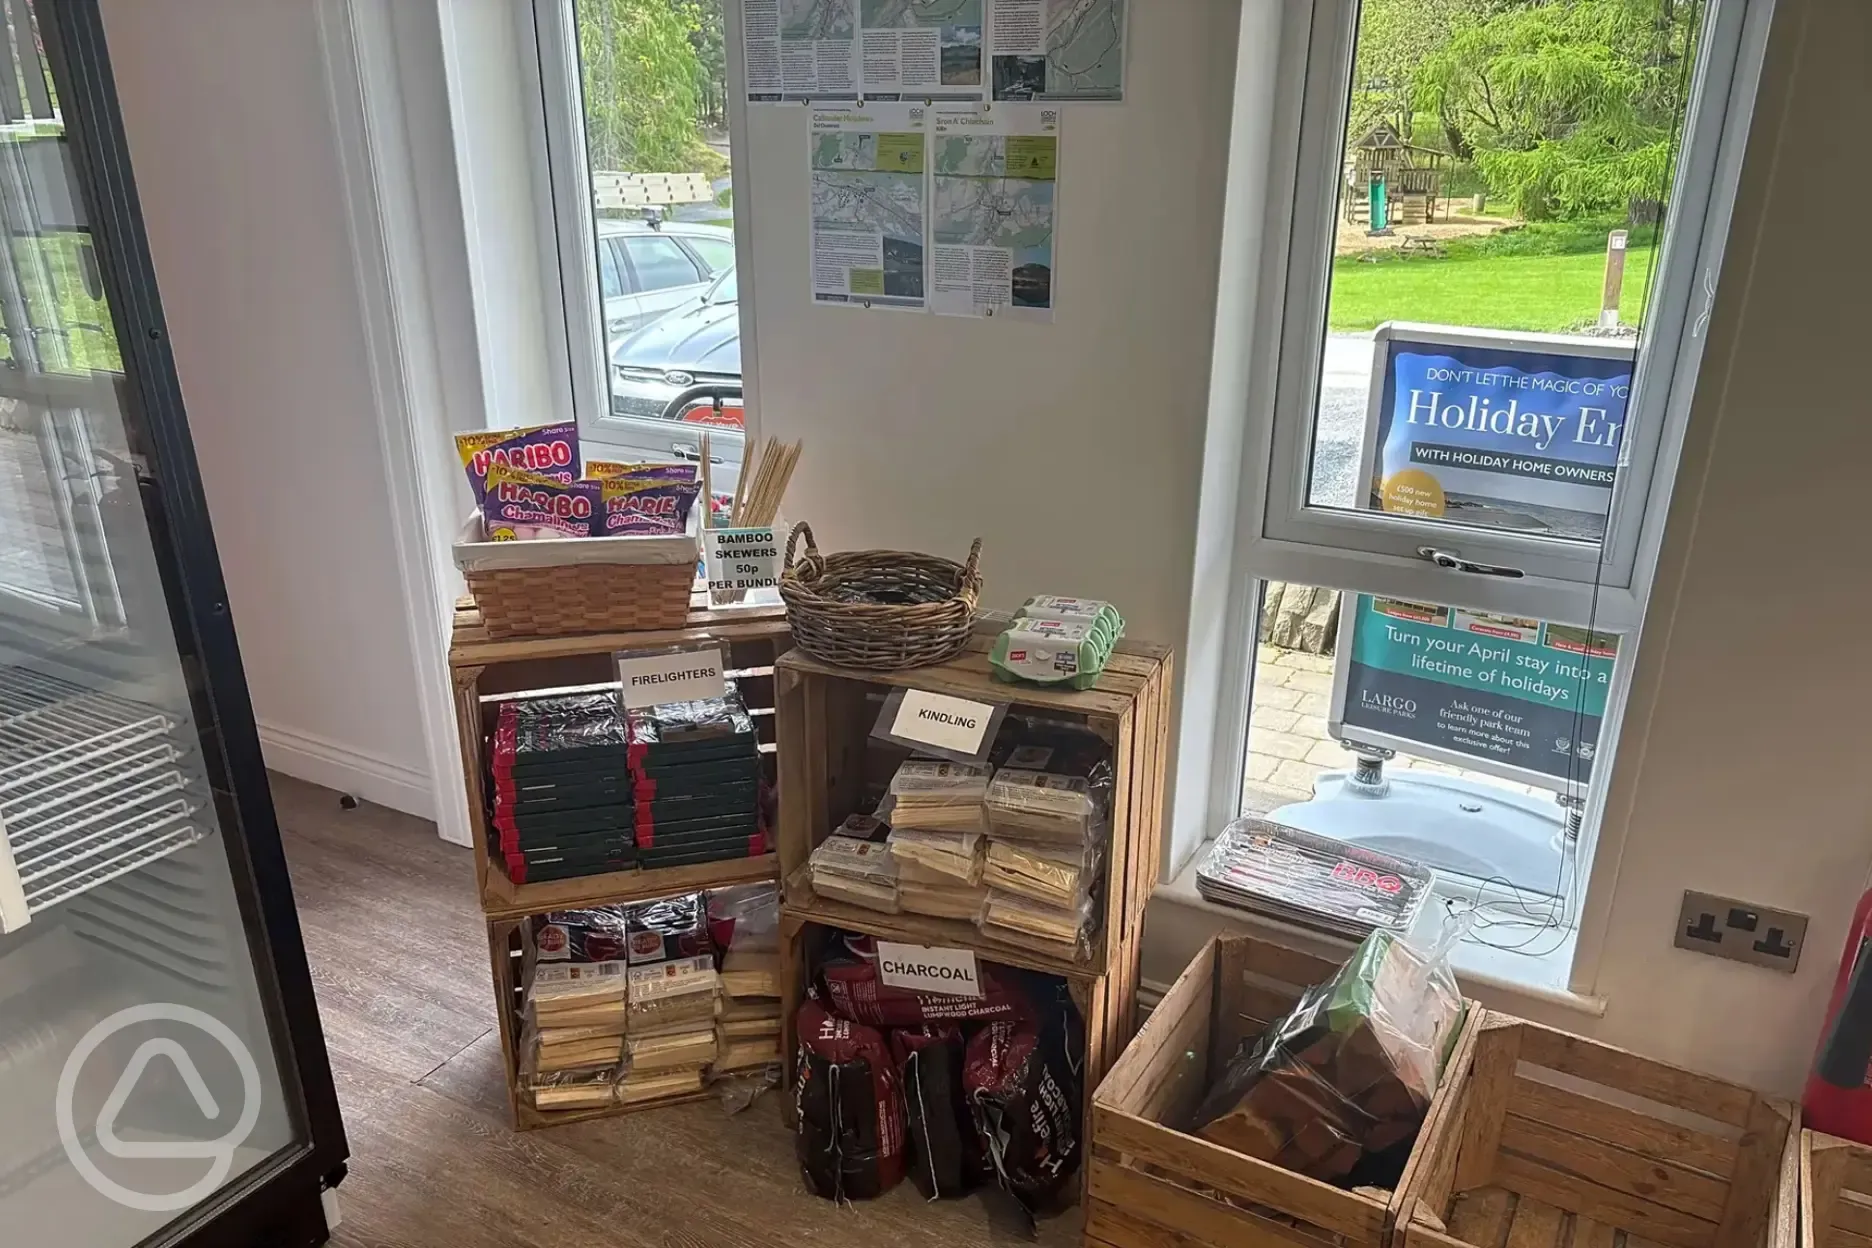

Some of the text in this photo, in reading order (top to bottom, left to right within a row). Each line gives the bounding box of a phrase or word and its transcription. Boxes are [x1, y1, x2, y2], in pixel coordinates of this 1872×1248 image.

[1427, 368, 1629, 399] DON'T LET THE MAGIC OF YO
[1406, 389, 1622, 450] Holiday En
[542, 427, 563, 436] Share
[473, 440, 572, 477] HARIBO
[1415, 447, 1614, 482] WITH HOLIDAY HOME OWNERS
[498, 480, 592, 519] HARIBO
[1415, 489, 1432, 498] new
[1415, 499, 1437, 509] home
[717, 533, 773, 544] BAMBOO
[715, 548, 777, 559] SKEWERS
[736, 564, 758, 575] 50p
[708, 578, 780, 590] PER BUNDL
[1385, 624, 1607, 684] Turn your April stay into a
[631, 668, 716, 686] FIRELIGHTERS
[1411, 653, 1570, 701] lifetime of holidays
[1361, 702, 1416, 719] LEISURE PARKS
[1362, 689, 1417, 713] LARGO
[918, 708, 977, 729] KINDLING
[1439, 708, 1531, 737] friendly park team
[1450, 700, 1523, 724] Ask one of our
[1447, 723, 1467, 734] learn
[1468, 729, 1490, 739] more
[1491, 732, 1514, 746] about
[1515, 739, 1530, 749] this
[1453, 735, 1511, 755] exclusive offer!
[1331, 862, 1403, 894] BBQ
[883, 960, 974, 981] CHARCOAL
[921, 1002, 977, 1013] INSTANT LIGHT
[923, 1004, 1012, 1018] LUMPWOOD CHARCOAL
